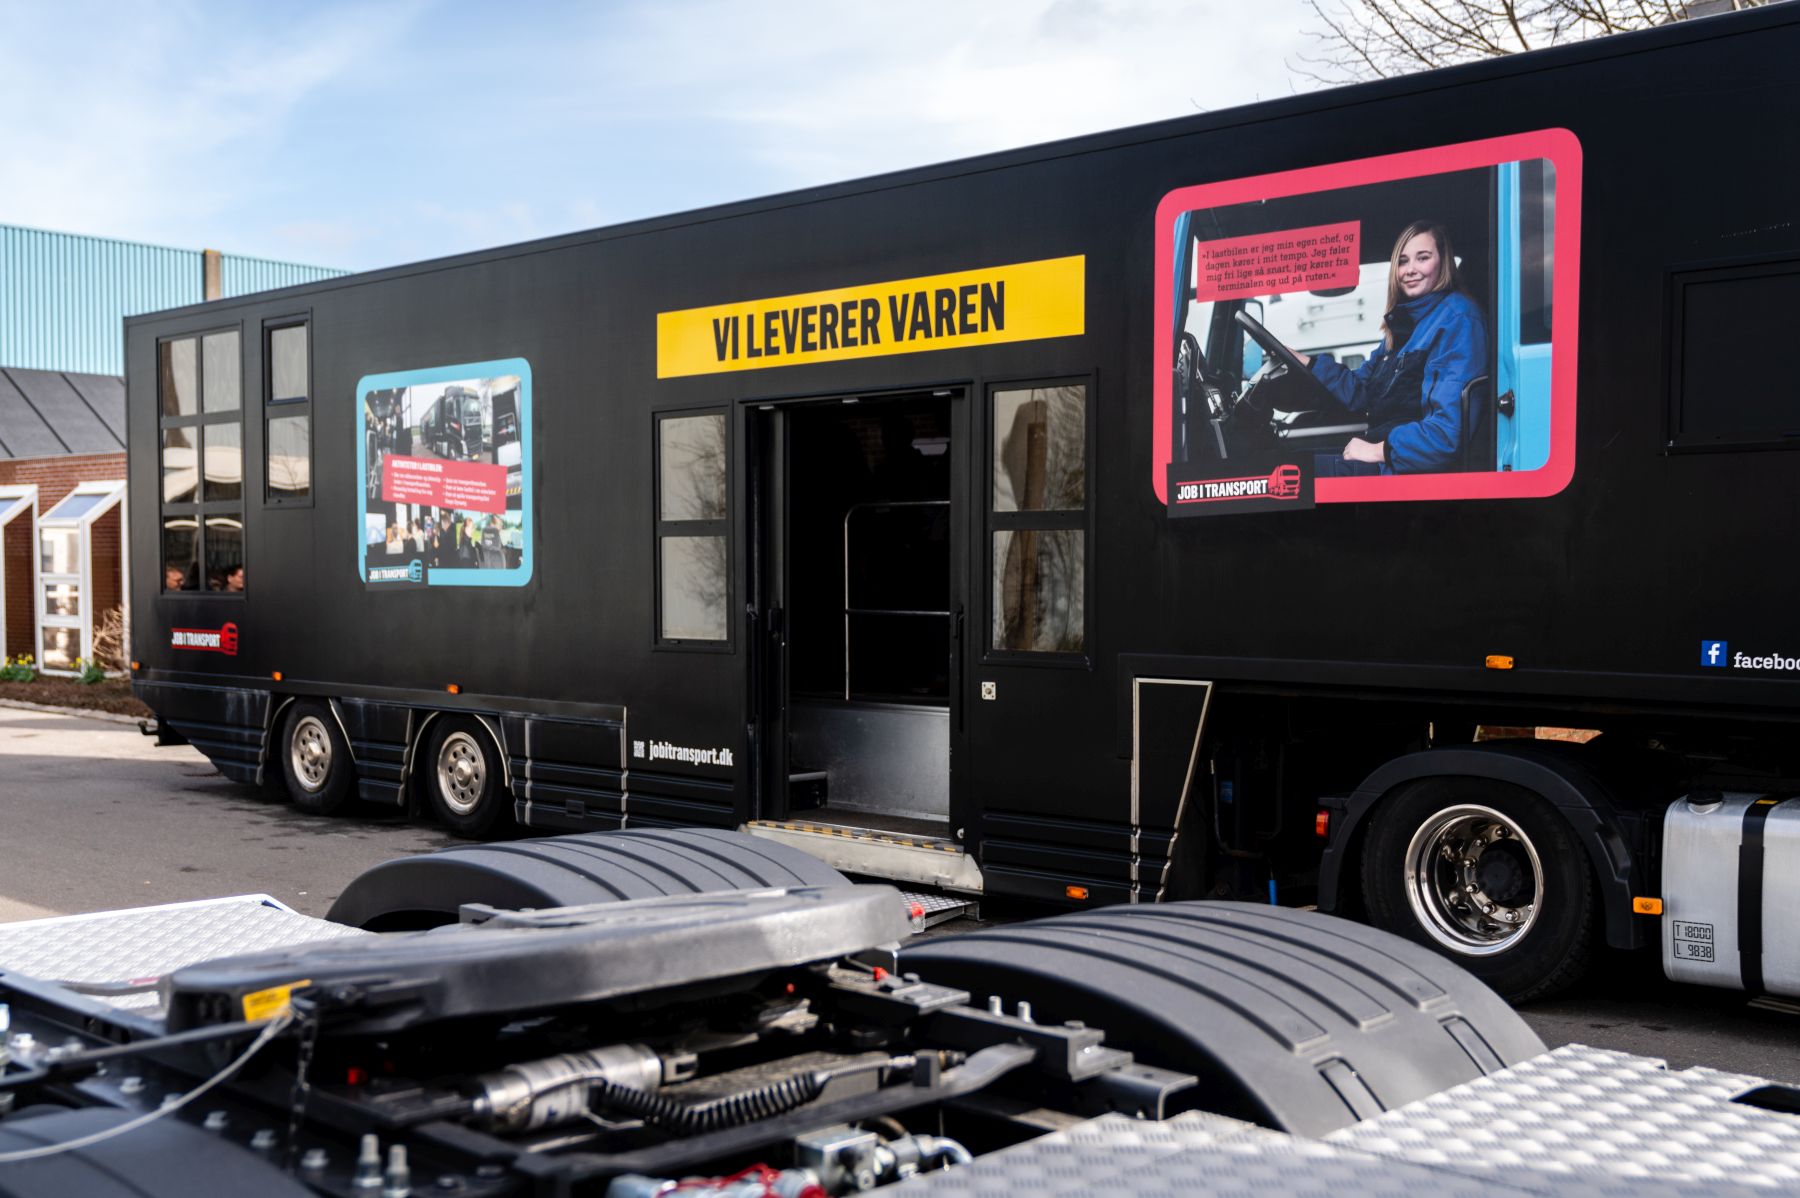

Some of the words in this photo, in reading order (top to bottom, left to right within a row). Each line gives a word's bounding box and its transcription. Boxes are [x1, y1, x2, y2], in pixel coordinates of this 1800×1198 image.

[1206, 261, 1230, 272] dagen
[1232, 257, 1254, 268] kører
[1263, 254, 1277, 264] mit
[1311, 249, 1327, 258] Jeg
[1330, 245, 1350, 255] føler
[1212, 246, 1248, 259] lastbilen
[1250, 246, 1259, 254] er
[1261, 244, 1274, 255] jeg
[1277, 239, 1294, 250] min
[1296, 238, 1317, 249] egen
[1344, 233, 1354, 243] og
[1206, 272, 1222, 283] mig
[1224, 270, 1234, 280] fri
[1236, 268, 1252, 279] lige
[1254, 266, 1265, 276] så
[1294, 262, 1307, 273] jeg
[1310, 259, 1333, 270] kører
[1336, 257, 1349, 267] fra
[1217, 279, 1264, 292] terminalen
[1266, 278, 1277, 288] og
[1279, 275, 1289, 285] ud
[1292, 274, 1303, 286] på
[712, 316, 739, 362] VI
[746, 297, 881, 359] LEVERER
[889, 280, 1005, 342] VAREN
[1177, 484, 1199, 500] JOB
[1199, 483, 1204, 499] I
[1204, 479, 1269, 498] TRANSPORT
[649, 739, 734, 767] jobitransport.dk
[1675, 924, 1681, 937] T
[1684, 925, 1712, 940] 18000
[1676, 942, 1681, 955] L
[1687, 944, 1712, 959] 9838
